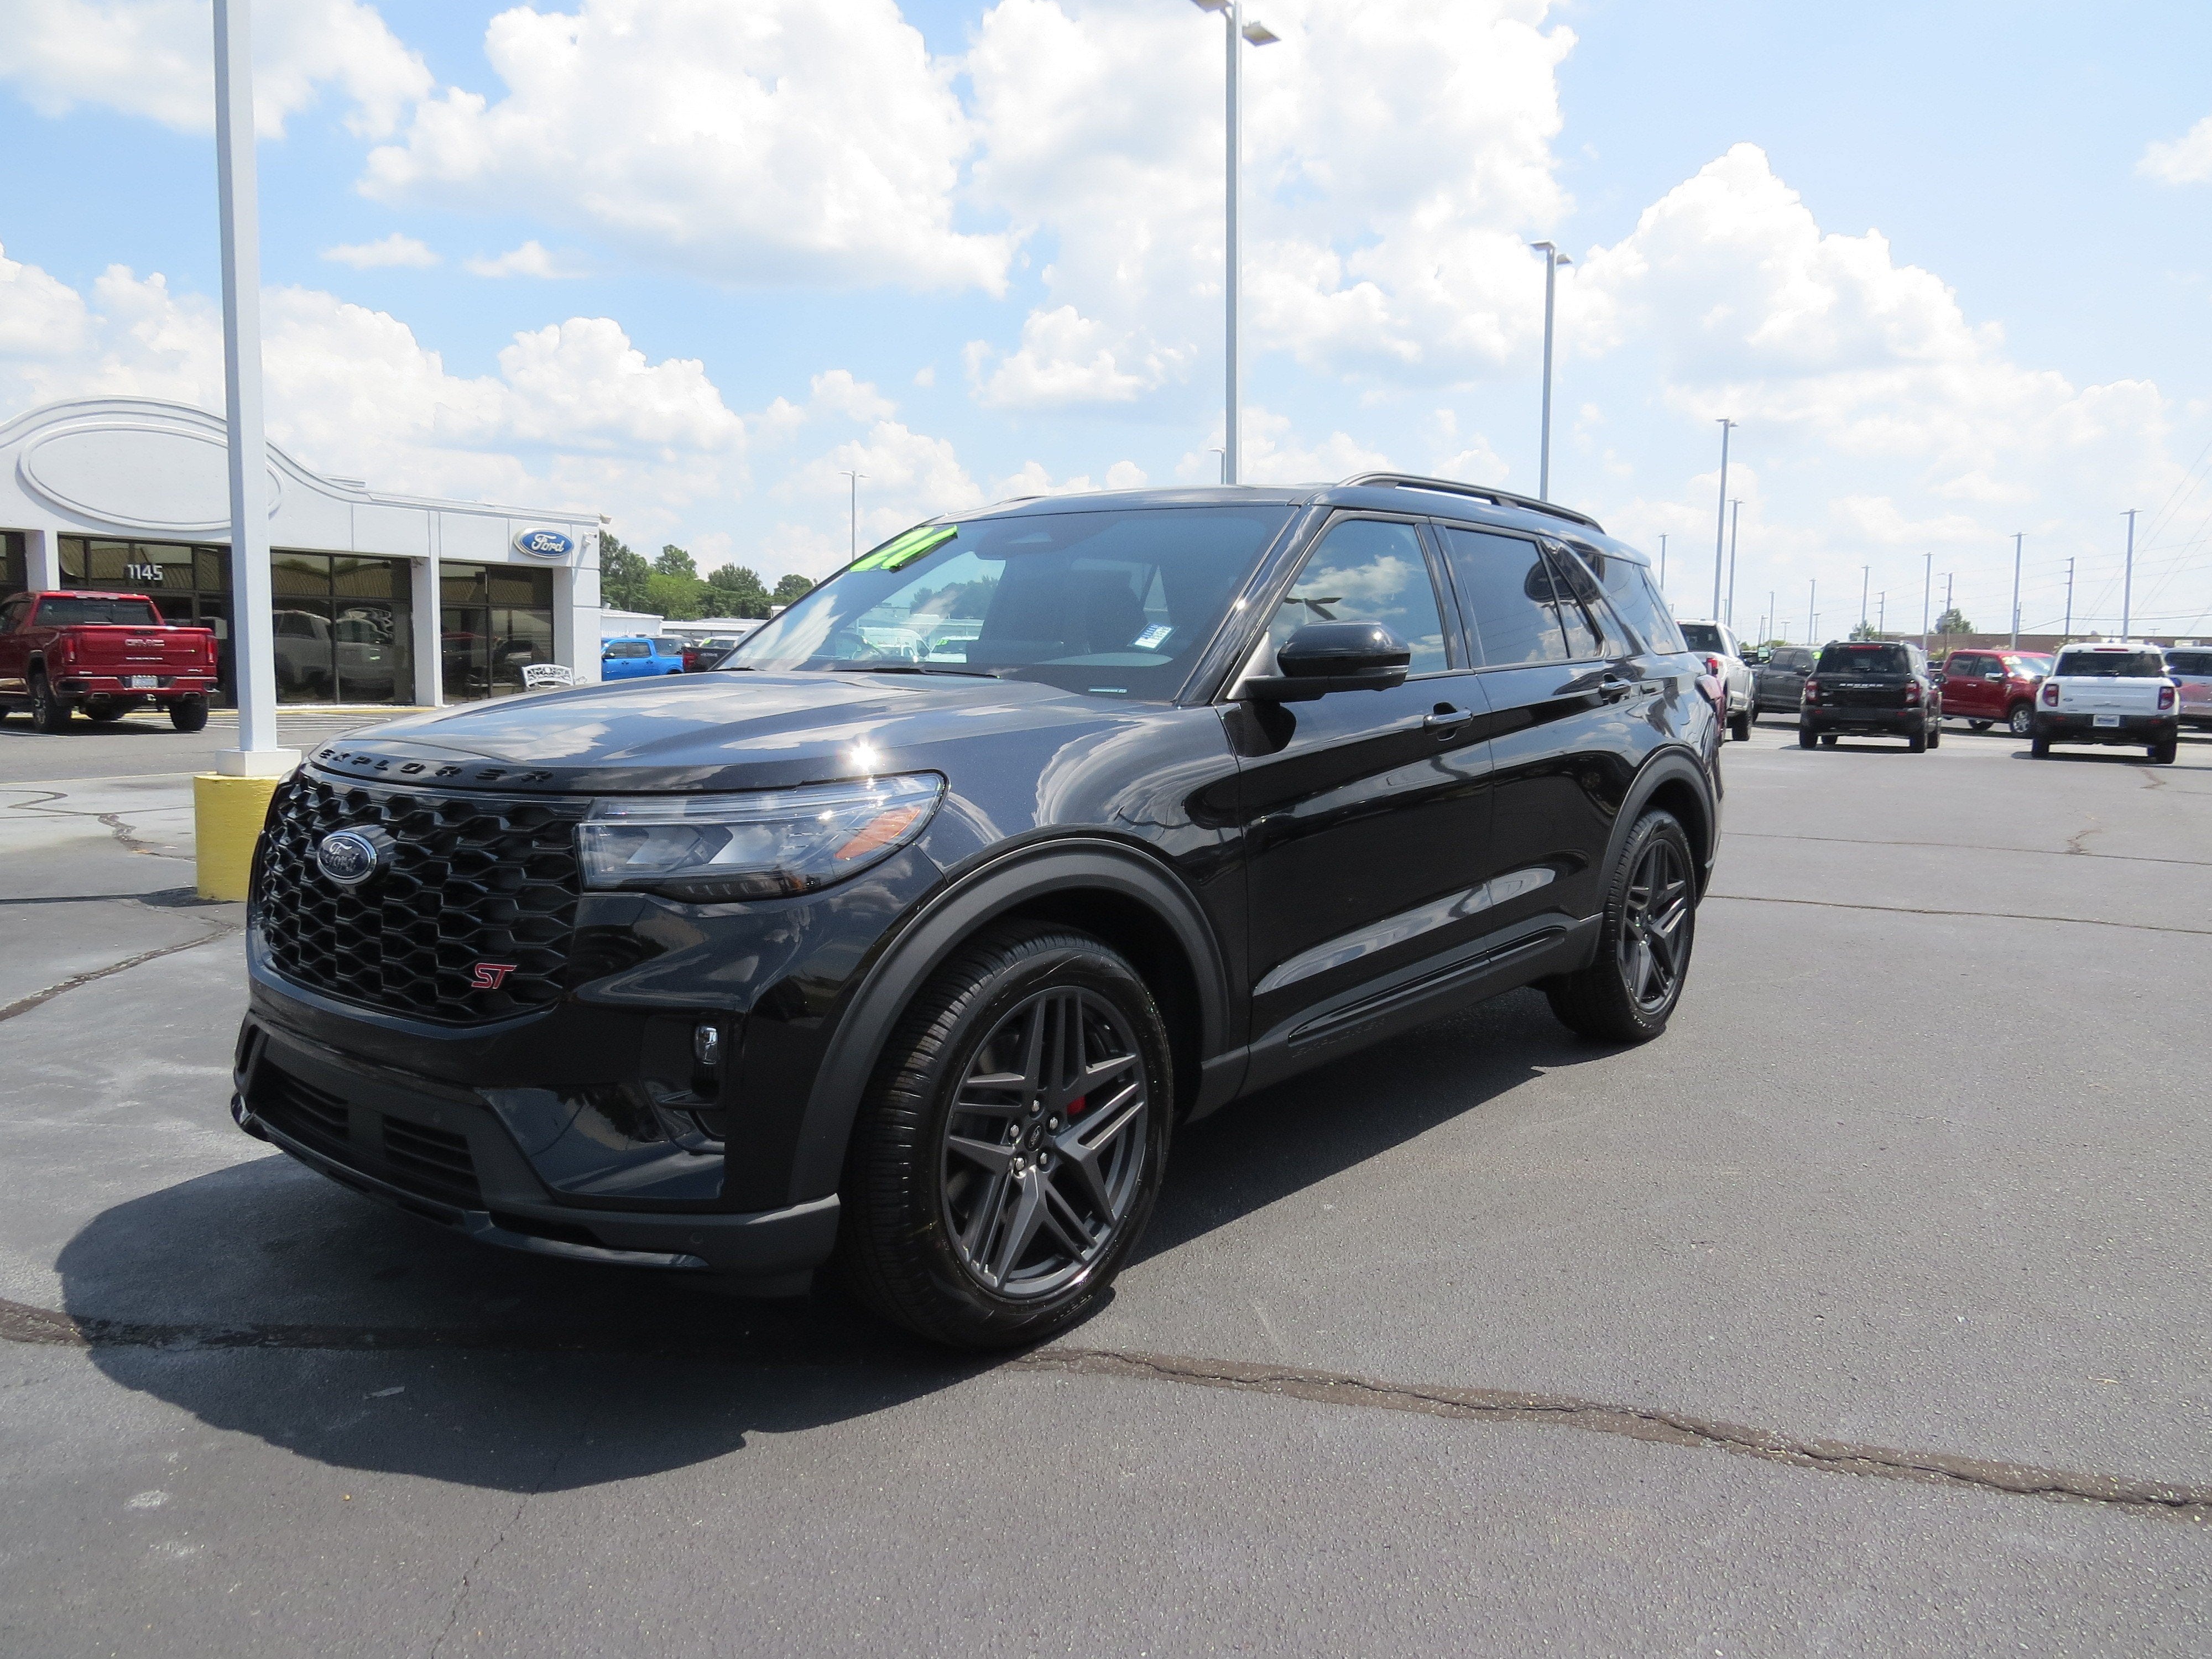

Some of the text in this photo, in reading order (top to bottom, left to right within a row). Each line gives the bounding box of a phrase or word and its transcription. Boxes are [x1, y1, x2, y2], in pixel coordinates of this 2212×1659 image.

[531, 534, 565, 552] Ford
[127, 564, 163, 581] 1145
[319, 749, 552, 782] EXPLORER
[325, 842, 359, 872] Ford
[471, 963, 518, 989] ST
